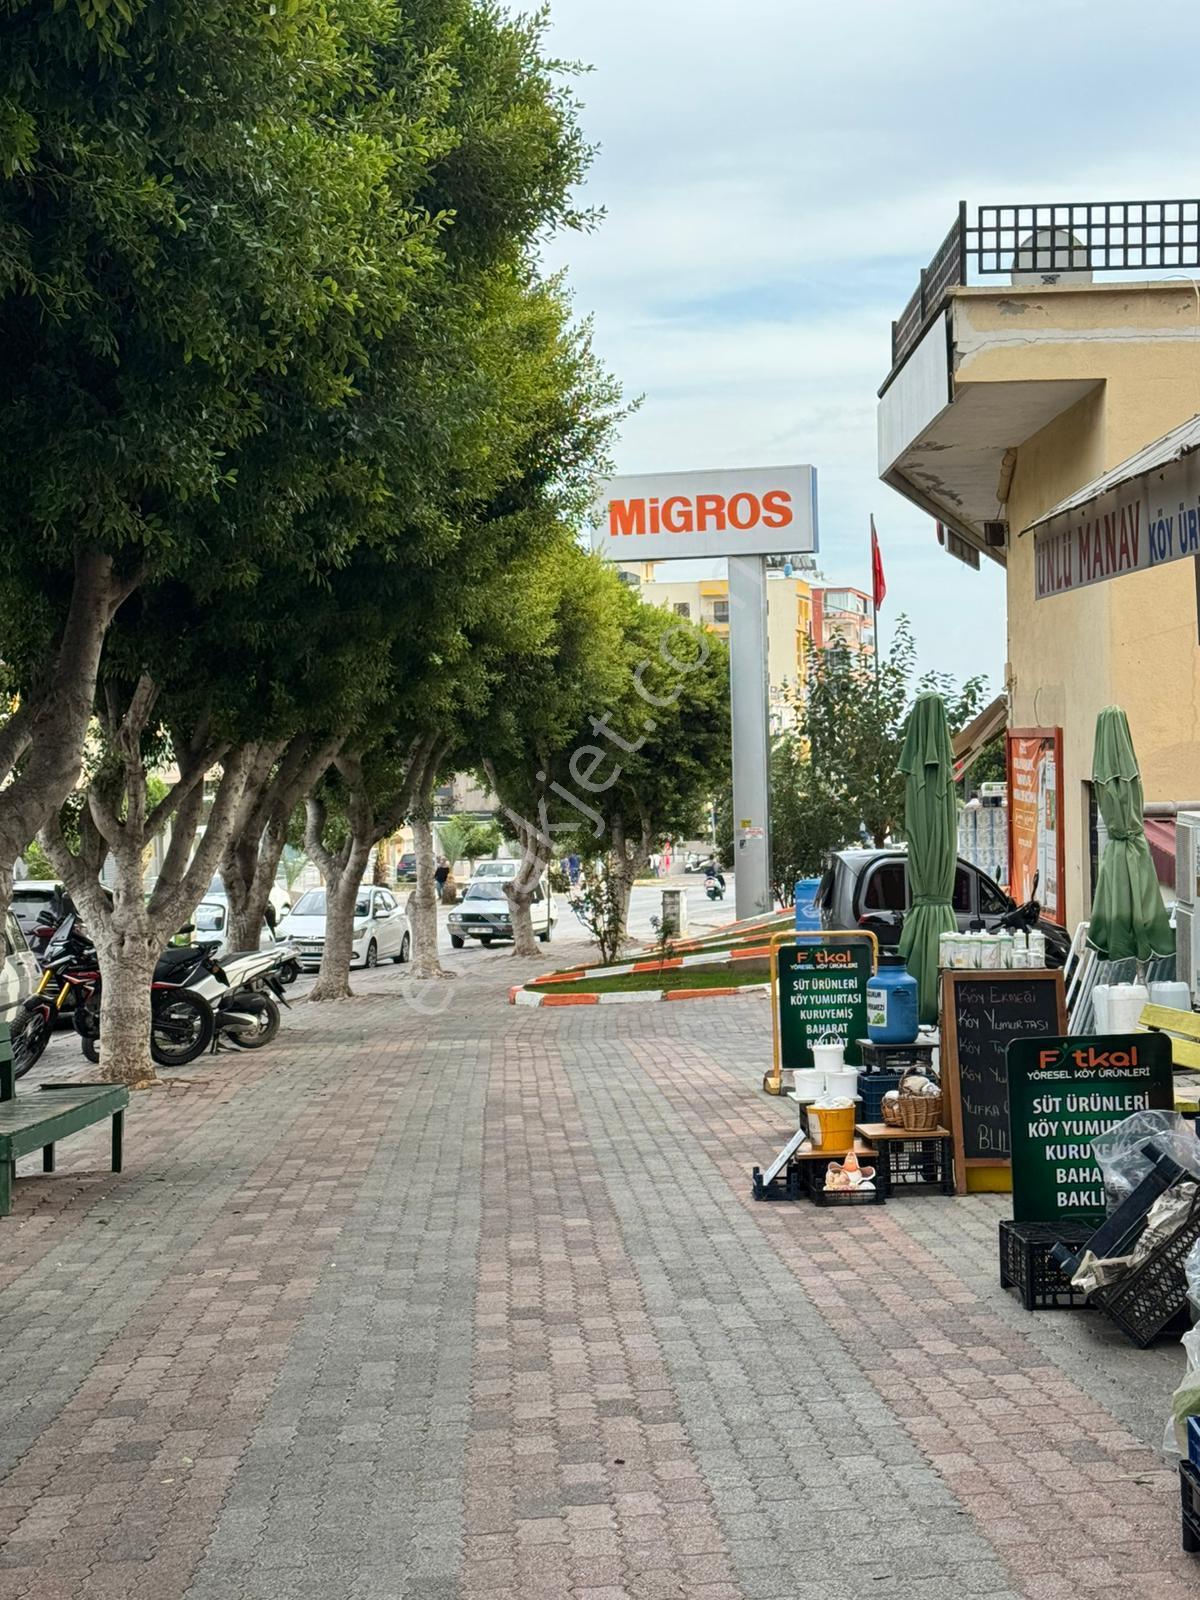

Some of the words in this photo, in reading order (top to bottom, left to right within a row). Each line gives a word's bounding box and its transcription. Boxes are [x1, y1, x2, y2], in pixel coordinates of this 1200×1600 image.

[1037, 529, 1073, 595] ÜNLÜ
[1077, 500, 1141, 583] MANAV
[1149, 508, 1174, 563] KÖY
[793, 978, 810, 990] SÜT
[812, 977, 858, 990] ÜRÜNLERİ
[790, 993, 808, 1006] KÖY
[810, 993, 862, 1005] YUMURTASI
[800, 1007, 853, 1020] KURUYEMİŞ
[806, 1023, 849, 1035] BAHARAT
[1027, 1069, 1072, 1080] YÖRESEL
[1074, 1068, 1097, 1079] KÖY
[1098, 1066, 1151, 1078] ÜRÜNLERİ
[1032, 1094, 1062, 1114] SÜT
[1066, 1091, 1150, 1112] ÜRÜNLERİ
[1028, 1119, 1059, 1138] KÖY
[1056, 1167, 1102, 1184] BAHA
[1057, 1187, 1106, 1207] BAKLİ
